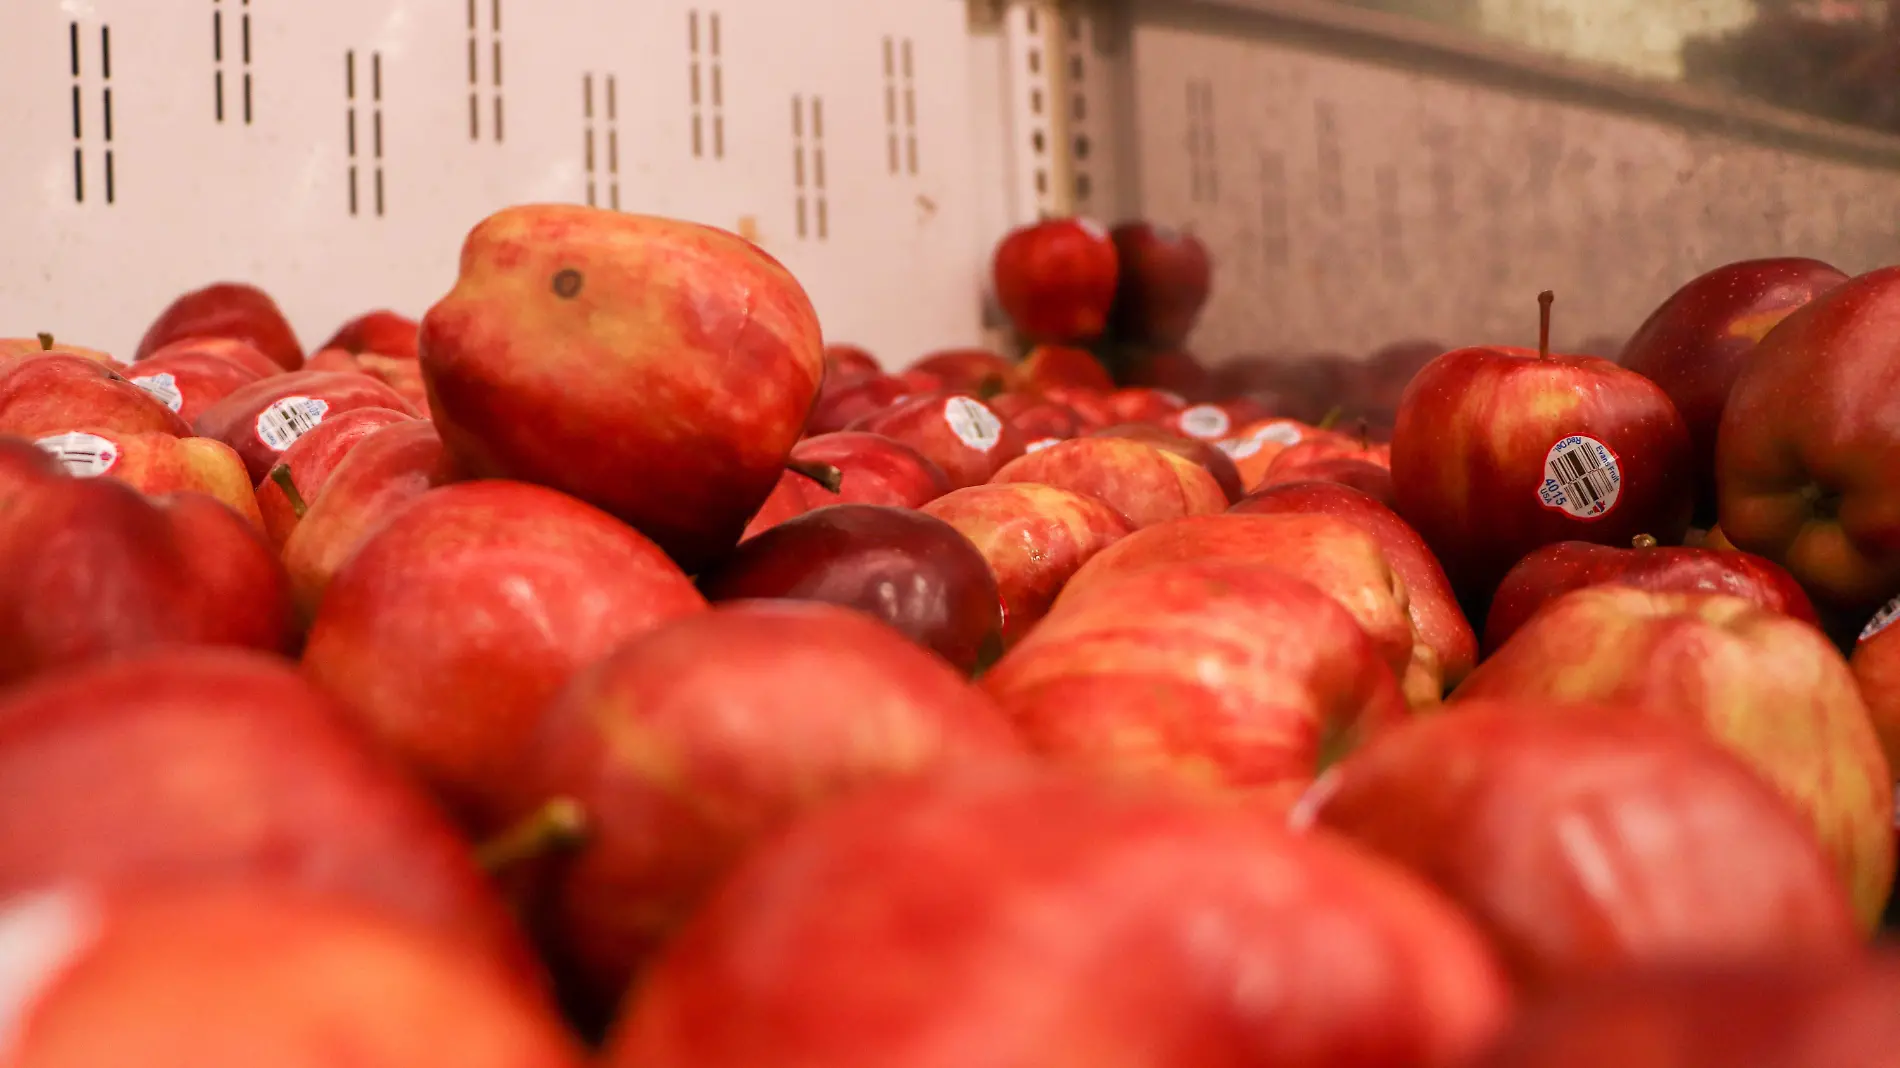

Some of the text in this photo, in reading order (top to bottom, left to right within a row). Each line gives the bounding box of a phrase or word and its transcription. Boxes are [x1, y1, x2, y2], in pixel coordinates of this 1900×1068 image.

[1566, 436, 1581, 445] Red
[1596, 445, 1619, 483] Evans Fruit
[1540, 488, 1552, 504] USA
[1546, 478, 1567, 505] 4015
